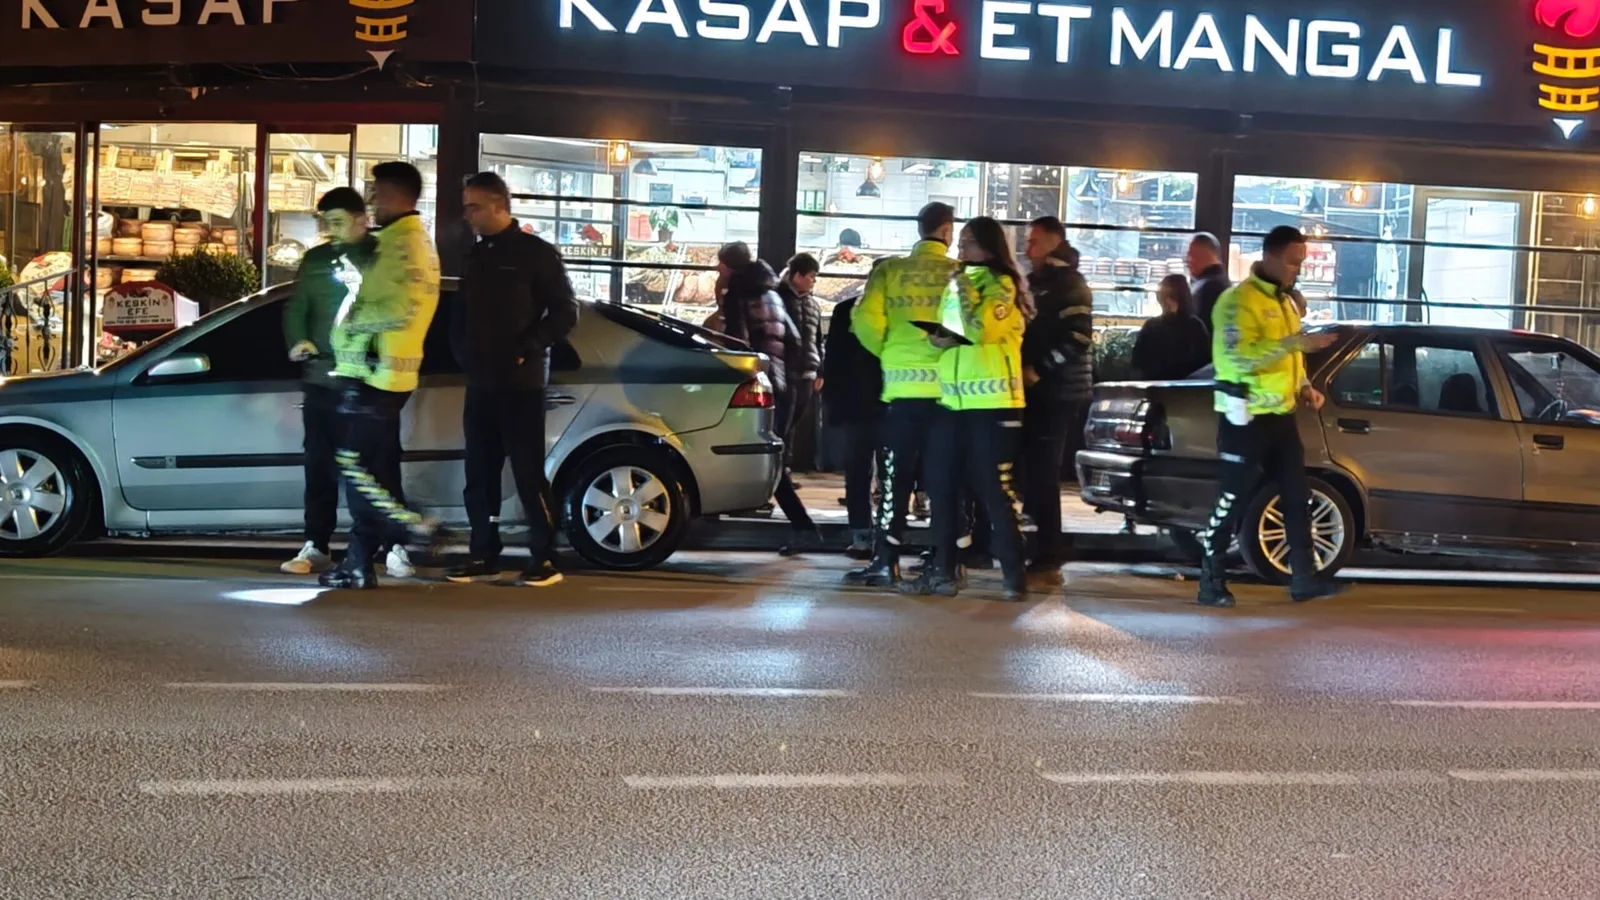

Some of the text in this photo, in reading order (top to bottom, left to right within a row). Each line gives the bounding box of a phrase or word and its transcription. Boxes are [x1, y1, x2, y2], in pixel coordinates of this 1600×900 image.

[903, 0, 959, 55] &
[980, 0, 1092, 63] ET
[1110, 7, 1482, 87] MANGAL
